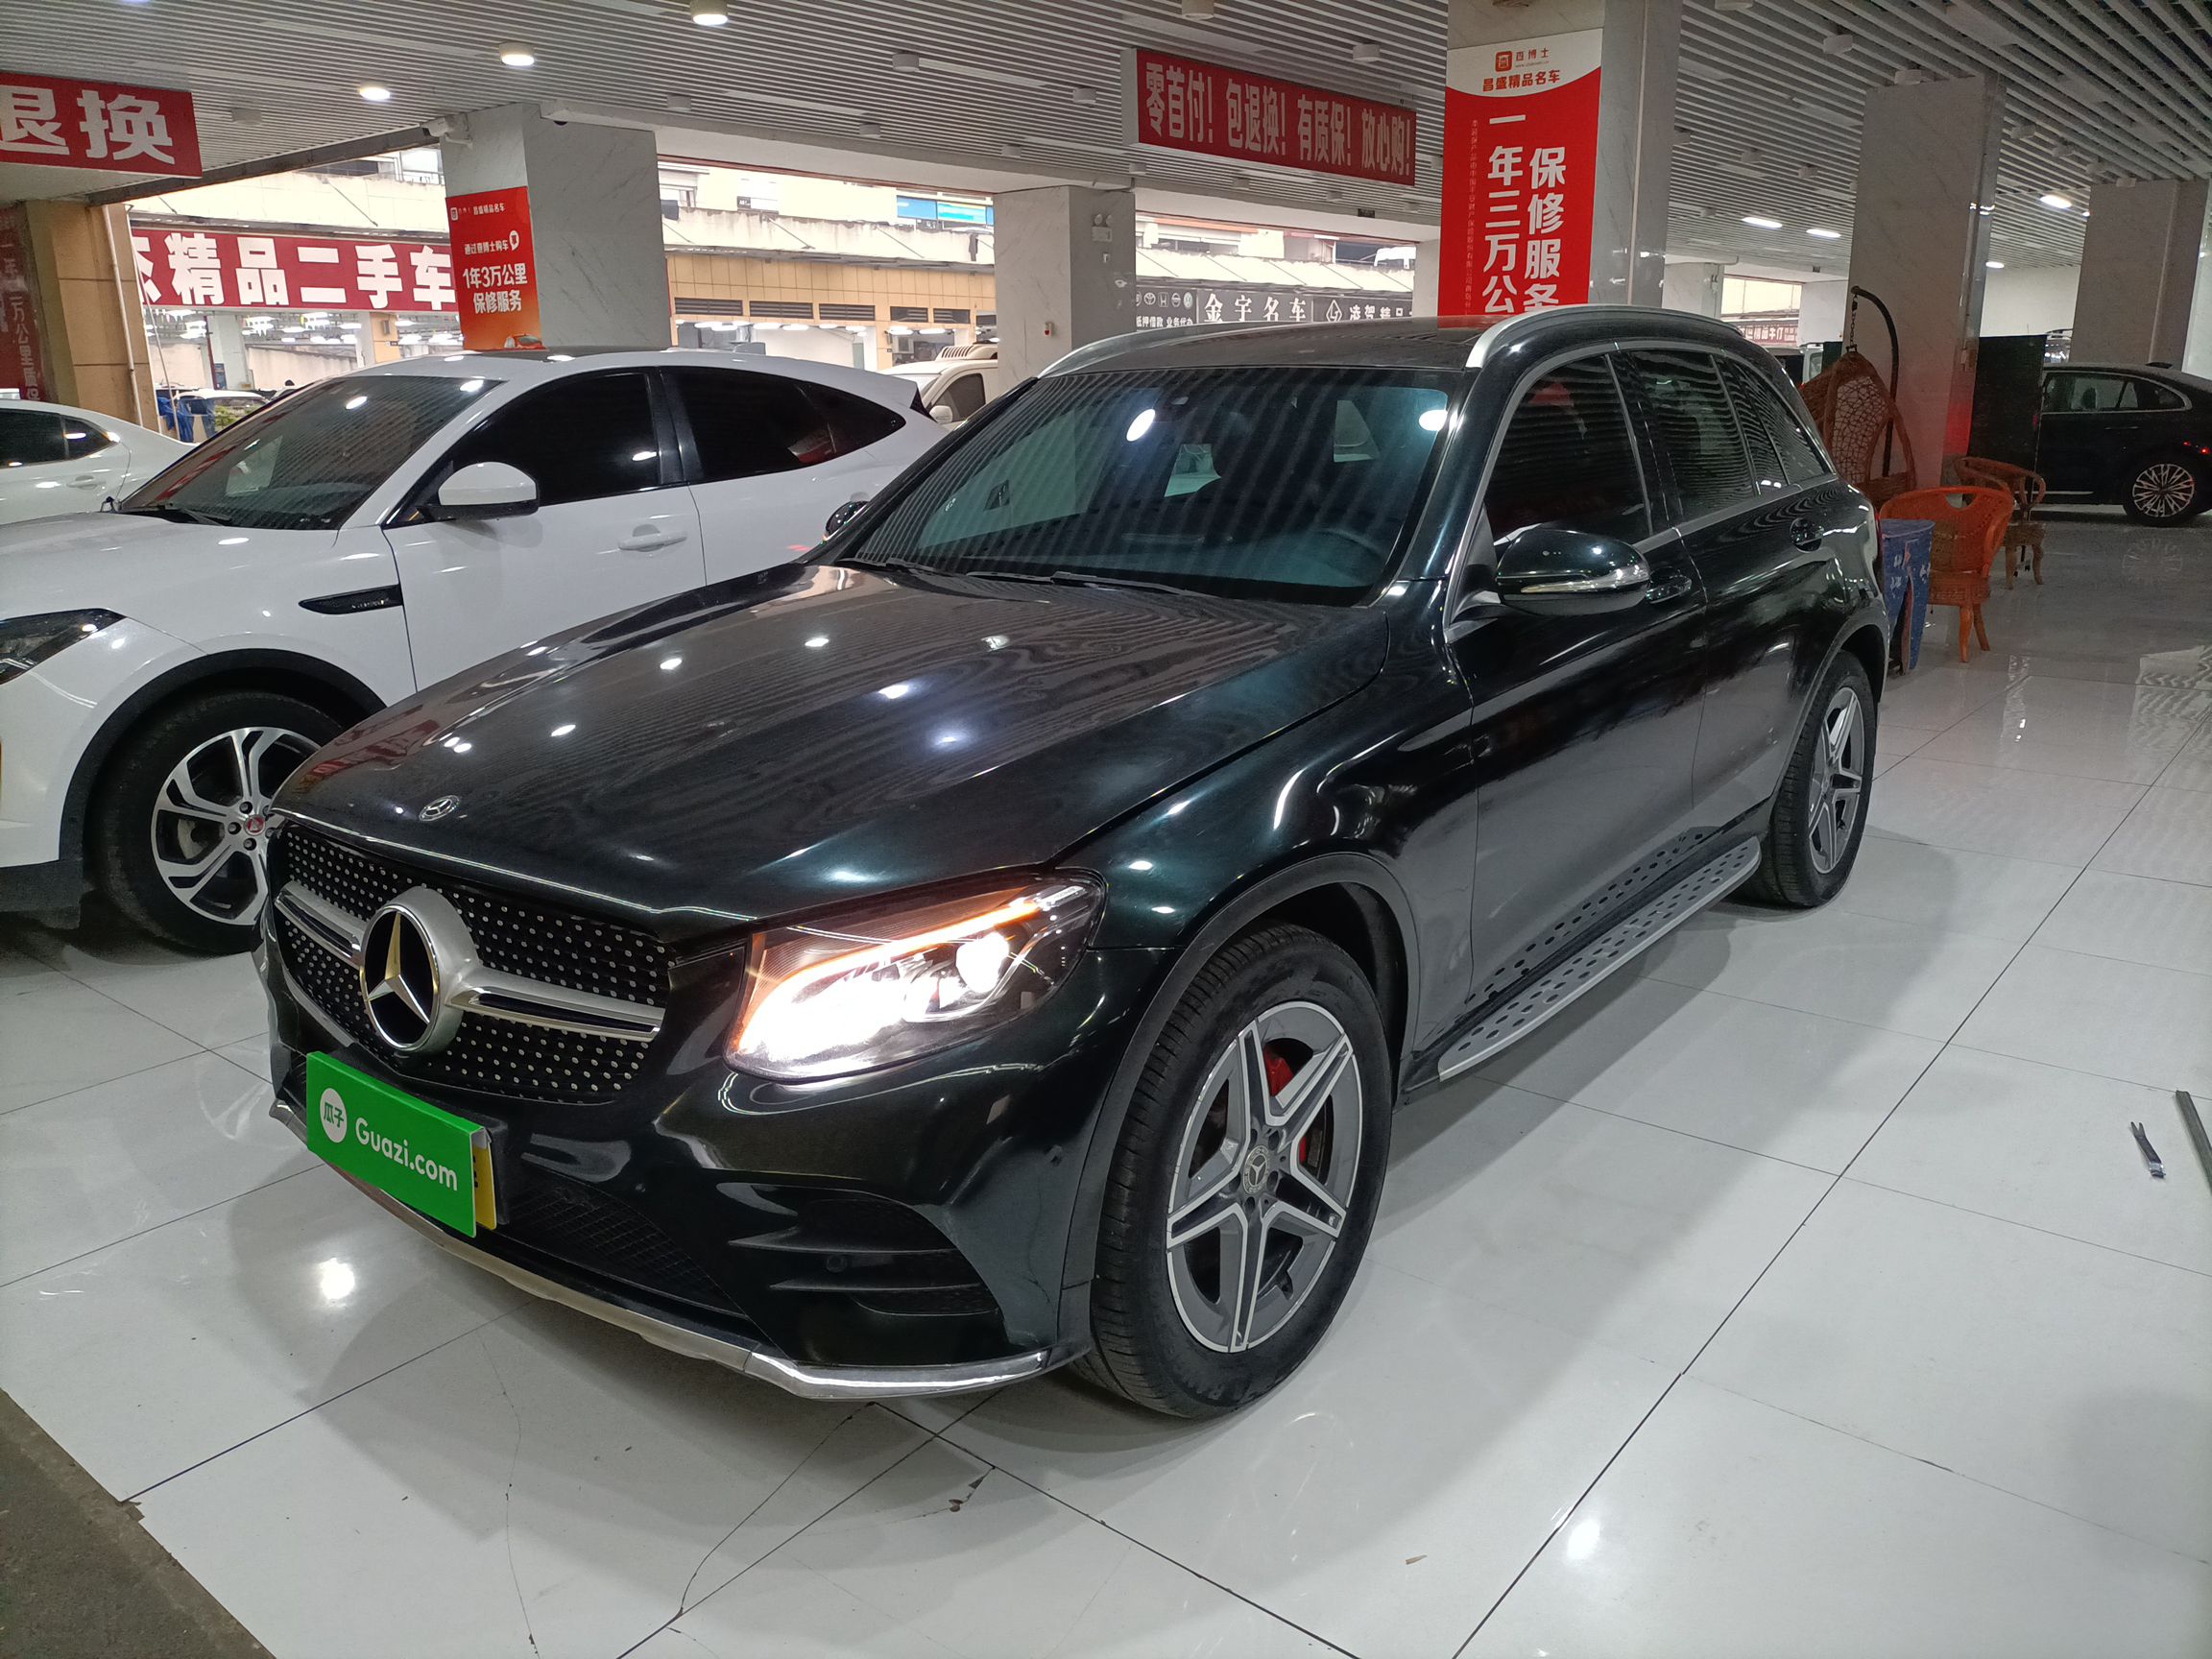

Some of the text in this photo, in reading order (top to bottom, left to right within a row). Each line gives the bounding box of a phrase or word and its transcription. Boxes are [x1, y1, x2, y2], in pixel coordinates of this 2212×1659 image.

[1482, 69, 1561, 92] 昌盛精品名车
[0, 84, 176, 165] 退换
[463, 262, 529, 289] 1年3万公里
[473, 290, 522, 314] 保修服务
[1203, 292, 1308, 323] 金宇名车
[323, 1101, 345, 1128] 瓜子
[354, 1117, 458, 1191] Guazi.com
